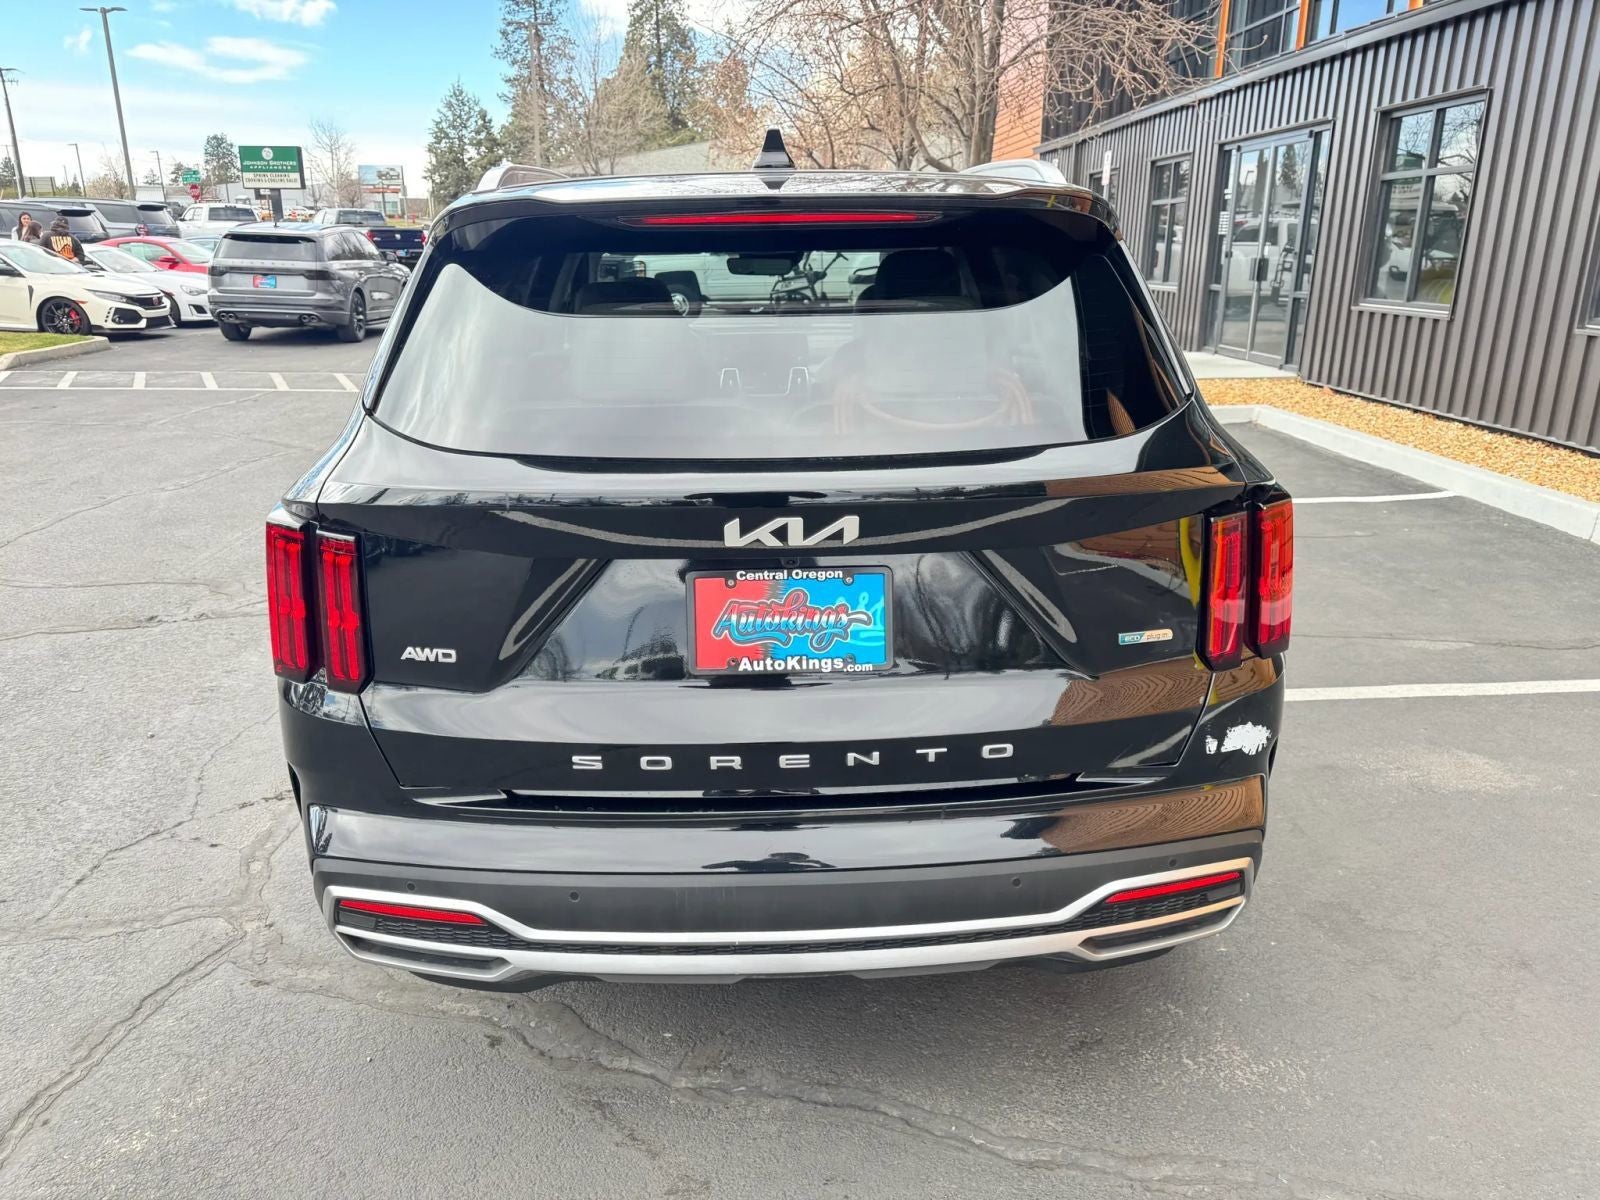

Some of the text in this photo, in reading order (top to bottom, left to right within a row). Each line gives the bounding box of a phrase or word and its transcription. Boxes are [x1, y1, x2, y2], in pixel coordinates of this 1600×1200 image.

[723, 514, 860, 547] KIA
[736, 569, 843, 581] Central Oregon
[400, 646, 457, 663] AWD
[571, 743, 1015, 770] SORENTO
